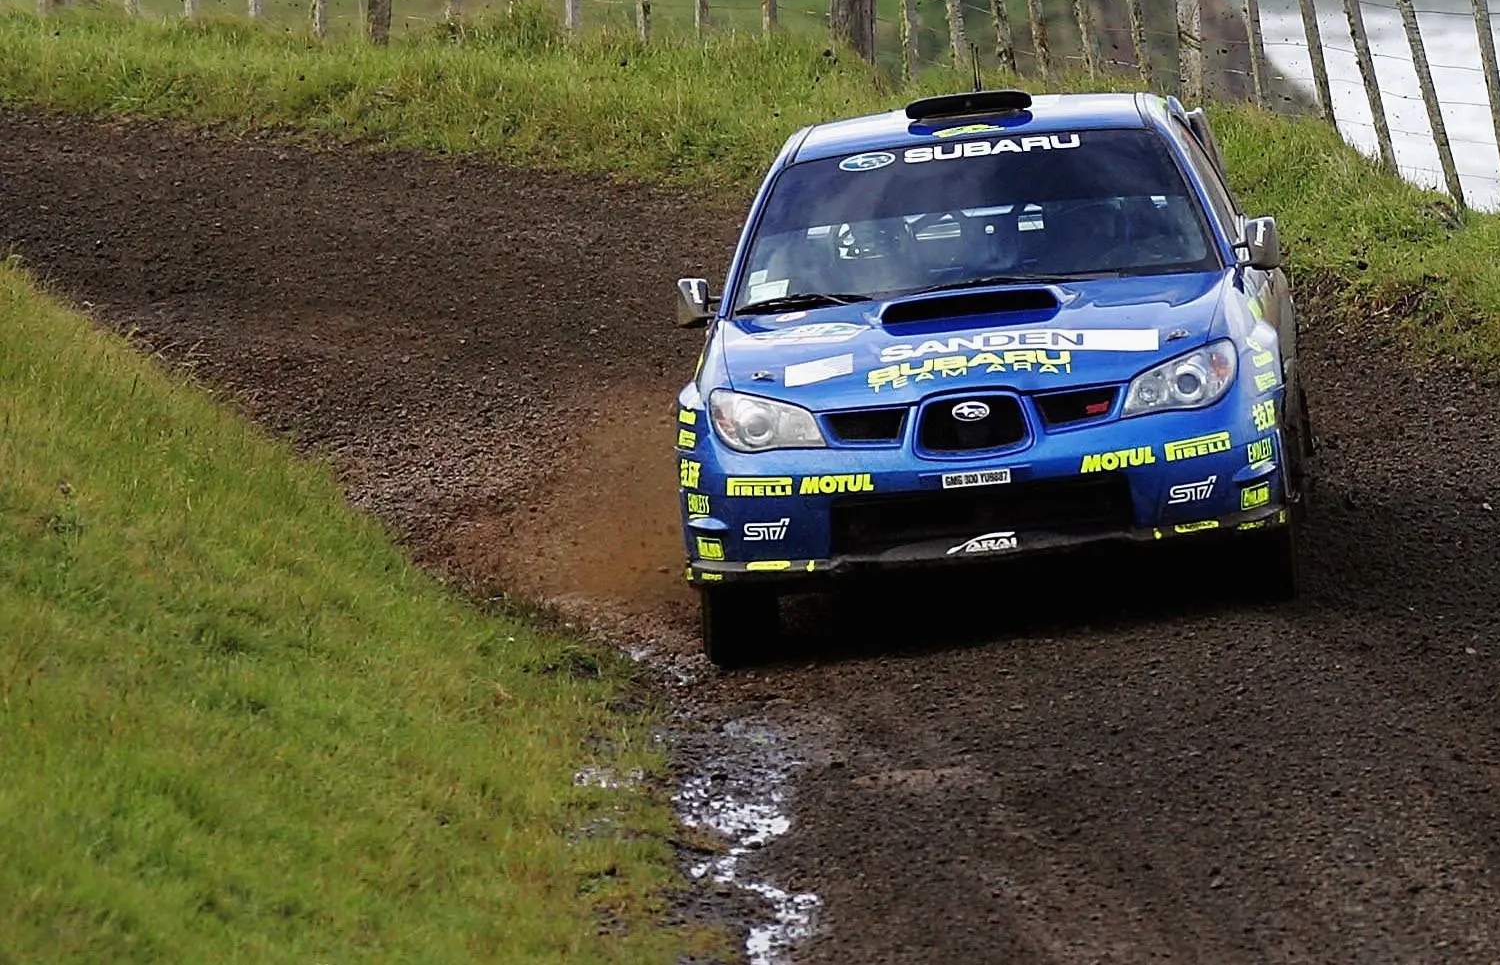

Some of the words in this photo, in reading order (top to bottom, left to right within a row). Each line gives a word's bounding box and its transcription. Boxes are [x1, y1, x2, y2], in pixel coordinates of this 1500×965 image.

[904, 133, 1080, 164] SUBARU
[881, 330, 1084, 362] SANDEN
[868, 349, 1072, 385] SUBARU
[872, 368, 966, 393] TEAM
[1080, 446, 1156, 473] MOTUL
[1164, 431, 1231, 461] PIRELLI
[1247, 437, 1272, 463] ENDLESS
[726, 477, 793, 496] PIRELLI
[799, 474, 874, 494] MOTUL
[966, 537, 1017, 552] ARAI
